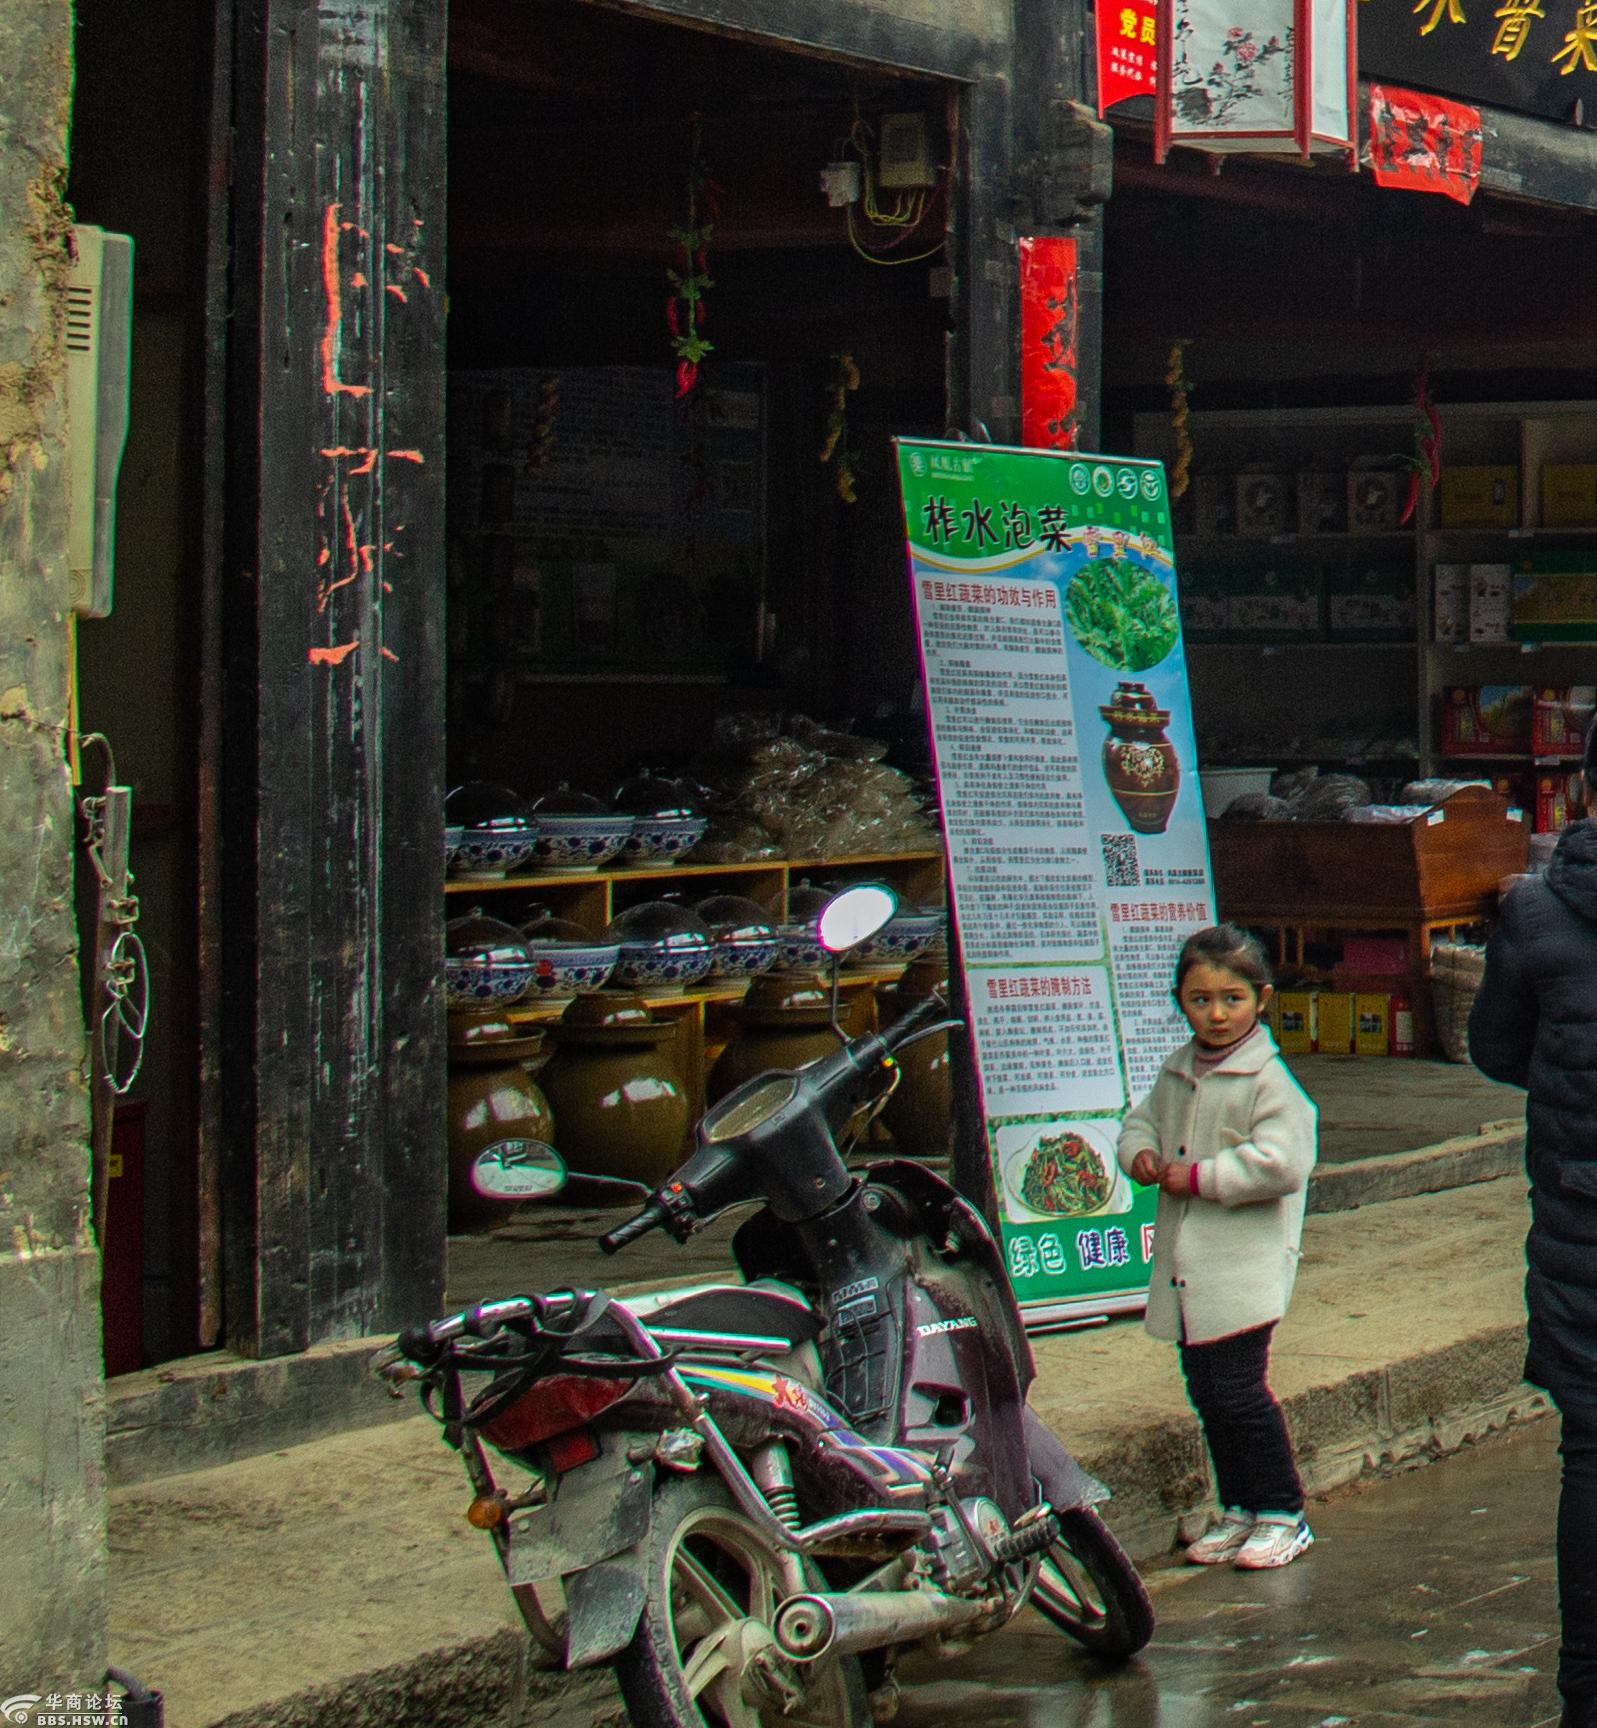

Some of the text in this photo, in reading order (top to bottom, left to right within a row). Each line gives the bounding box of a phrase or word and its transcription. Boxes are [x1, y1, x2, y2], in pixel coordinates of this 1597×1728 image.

[922, 494, 1073, 553] 柞水泡菜
[1008, 1232, 1067, 1278] 绿色
[1076, 1225, 1132, 1270] 健康
[916, 1316, 978, 1337] DAYANG
